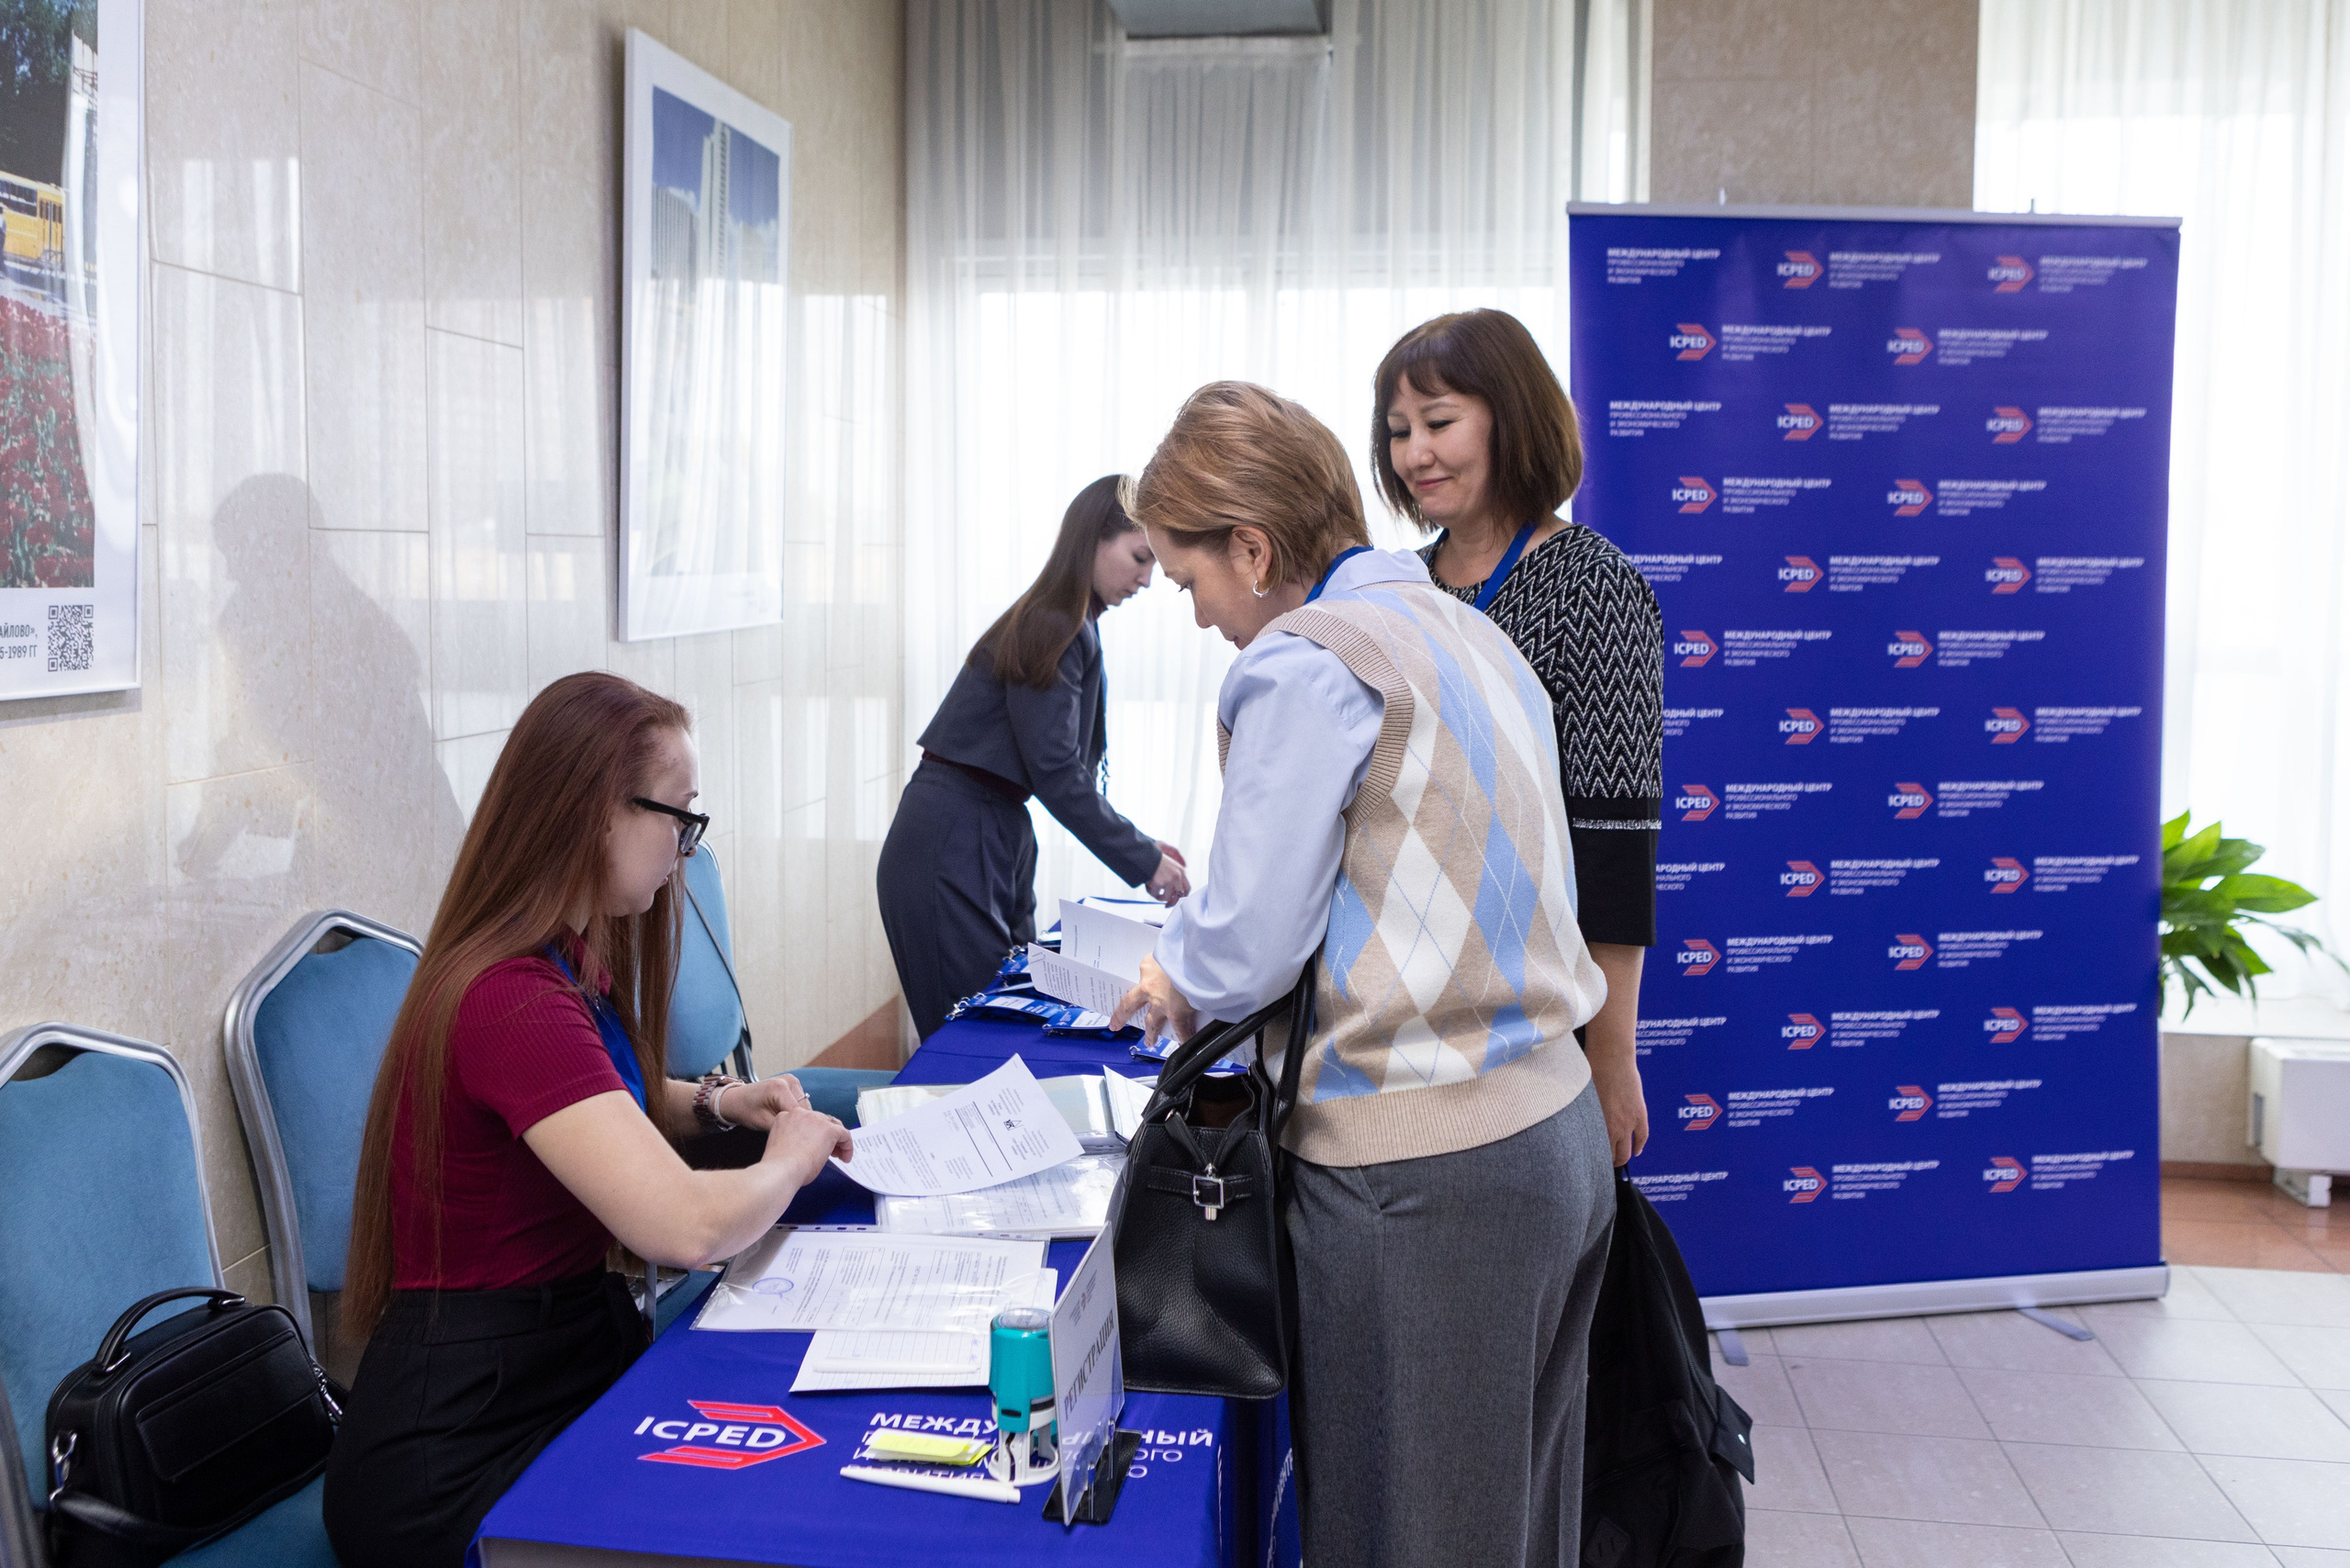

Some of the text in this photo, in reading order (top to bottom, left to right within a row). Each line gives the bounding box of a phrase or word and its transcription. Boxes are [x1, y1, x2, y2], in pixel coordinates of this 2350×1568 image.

[1777, 263, 1815, 276] ICPED
[1670, 336, 1707, 348] ICPED
[1886, 339, 1924, 353] ICPED
[1610, 400, 1721, 411] МЕЖДУНАРОДНЫЙ ЦЕНТР
[1778, 416, 1815, 429] ICPED
[1986, 419, 2023, 431] ICPED
[1723, 477, 1831, 488] МЕЖДУНАРОДНЫЙ ЦЕНТР
[1672, 489, 1708, 501] ICPED
[1886, 491, 1923, 504] ICPED
[1695, 554, 1722, 565] ЦЕНТР
[1778, 568, 1815, 580] ICPED
[1986, 568, 2022, 582] ICPED
[1724, 630, 1831, 640] МЕЖДУНАРОДНЫЙ ЦЕНТР
[1673, 643, 1709, 655] ICPED
[1888, 643, 1924, 655] ICPED
[1696, 708, 1724, 718] ЦЕНТР
[1780, 720, 1816, 732] ICPED
[1986, 719, 2021, 732] ICPED
[1726, 782, 1832, 793] МЕЖДУНАРОДНЫЙ ЦЕНТР
[1675, 797, 1711, 809] ICPED
[1888, 794, 1924, 806] ICPED
[1698, 862, 1725, 872] ЦЕНТР
[1781, 873, 1816, 884] ICPED
[1985, 868, 2020, 881] ICPED
[1727, 934, 1833, 946] МЕЖДУНАРОДНЫЙ ЦЕНТР
[1677, 951, 1712, 963] ICPED
[1889, 946, 1924, 958] ICPED
[1699, 1016, 1727, 1026] ЦЕНТР
[1984, 1018, 2019, 1031] ICPED
[1782, 1025, 1817, 1037] ICPED
[1729, 1087, 1834, 1101] МЕЖДУНАРОДНЫЙ ЦЕНТР
[1889, 1097, 1923, 1109] ICPED
[1680, 1106, 1714, 1118] ICPED
[1701, 1170, 1729, 1182] ЦЕНТР
[1984, 1168, 2018, 1181] ICPED
[1784, 1179, 1818, 1191] ICPED
[1064, 1309, 1113, 1421] РЕГИСТРАЦИЯ
[633, 1416, 786, 1448] ICPED
[869, 1412, 1214, 1447] МЕЖДУНЫЙ
